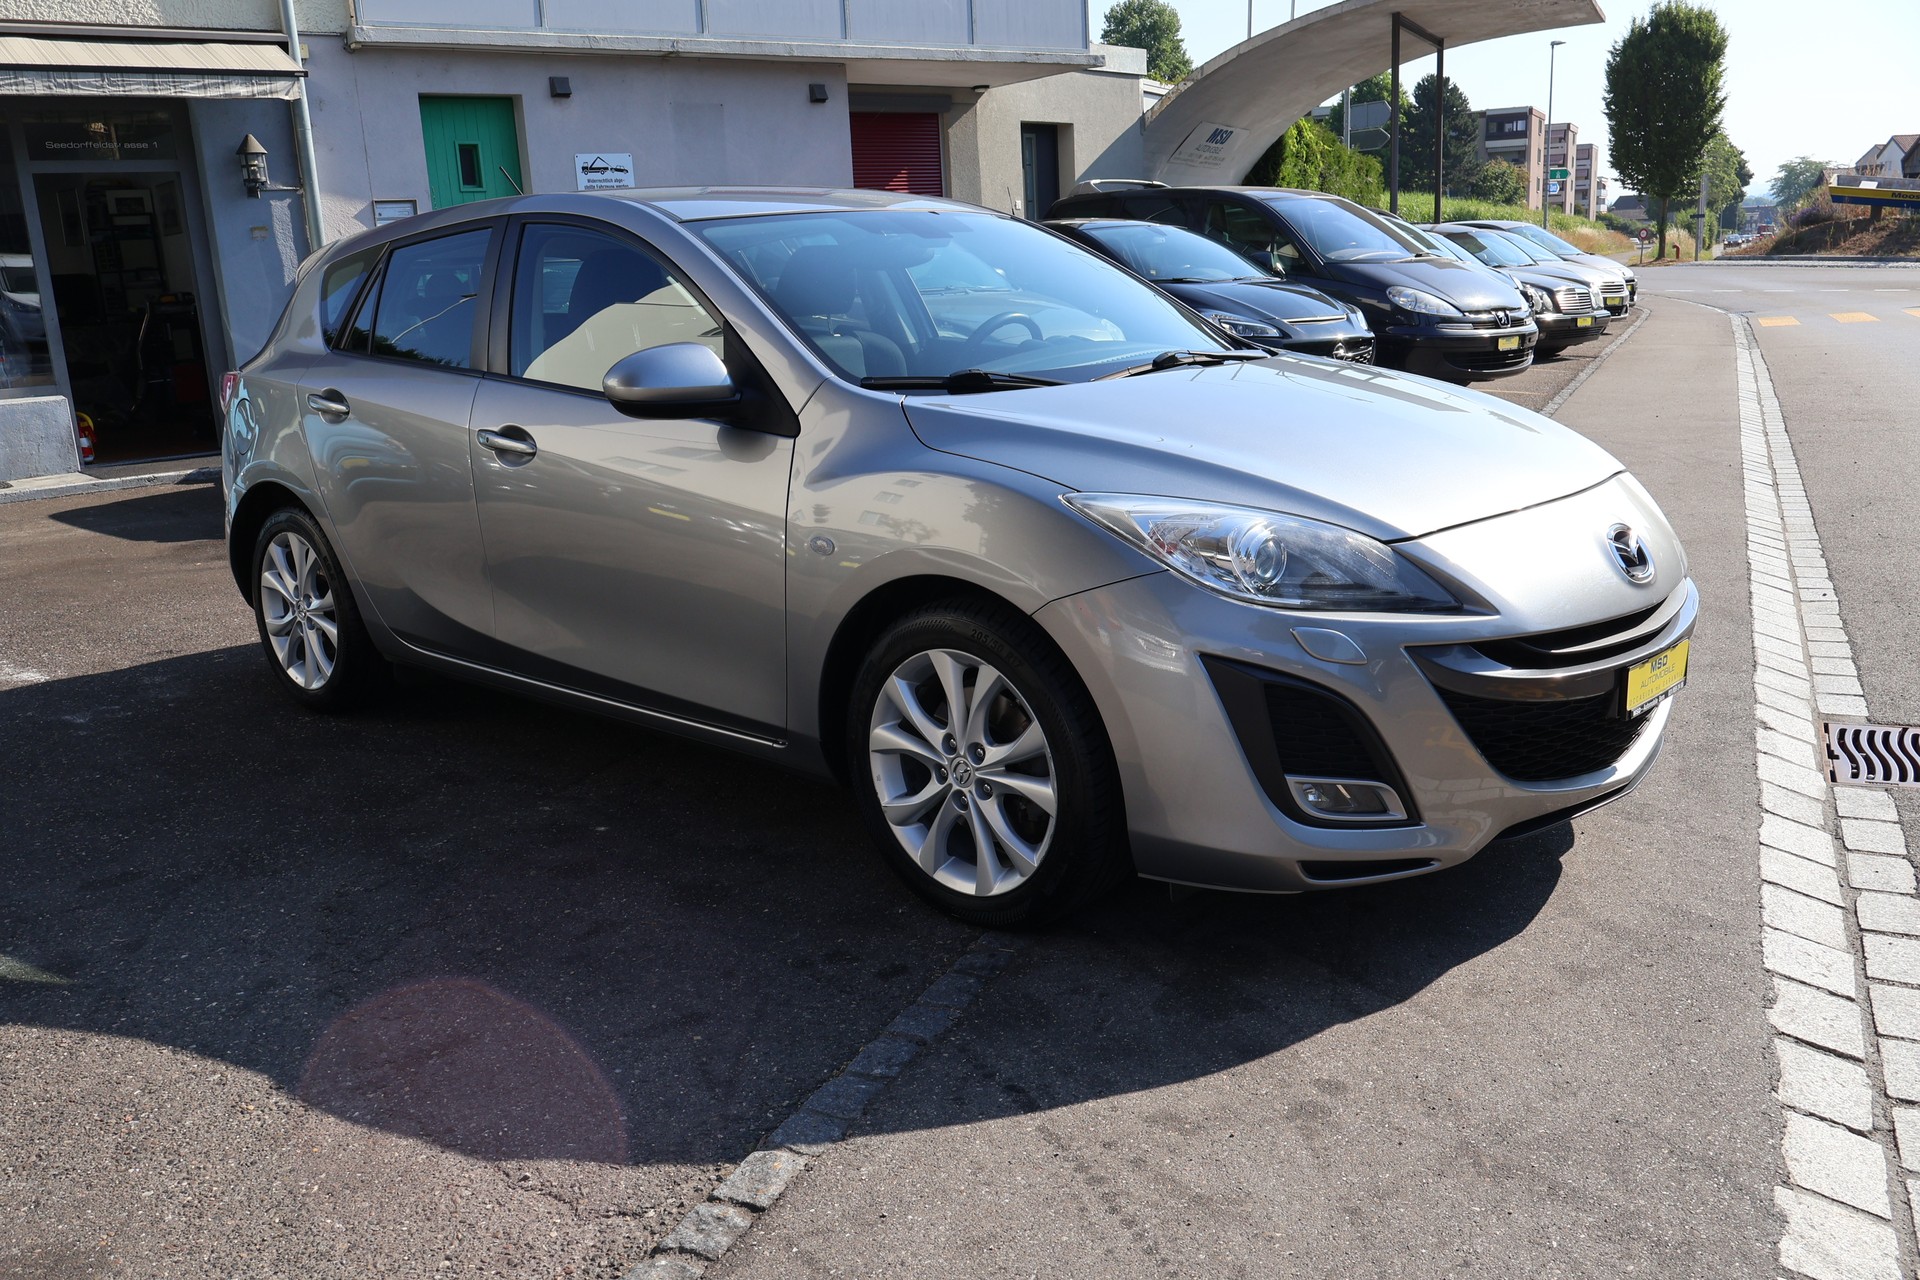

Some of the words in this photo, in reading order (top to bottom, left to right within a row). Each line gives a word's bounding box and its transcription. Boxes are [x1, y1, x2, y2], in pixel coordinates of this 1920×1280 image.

[152, 141, 158, 149] 1
[1205, 127, 1234, 145] MSD
[970, 628, 1005, 652] 205/50
[1650, 655, 1668, 673] MSD
[1640, 663, 1676, 688] AUTOMOBILE
